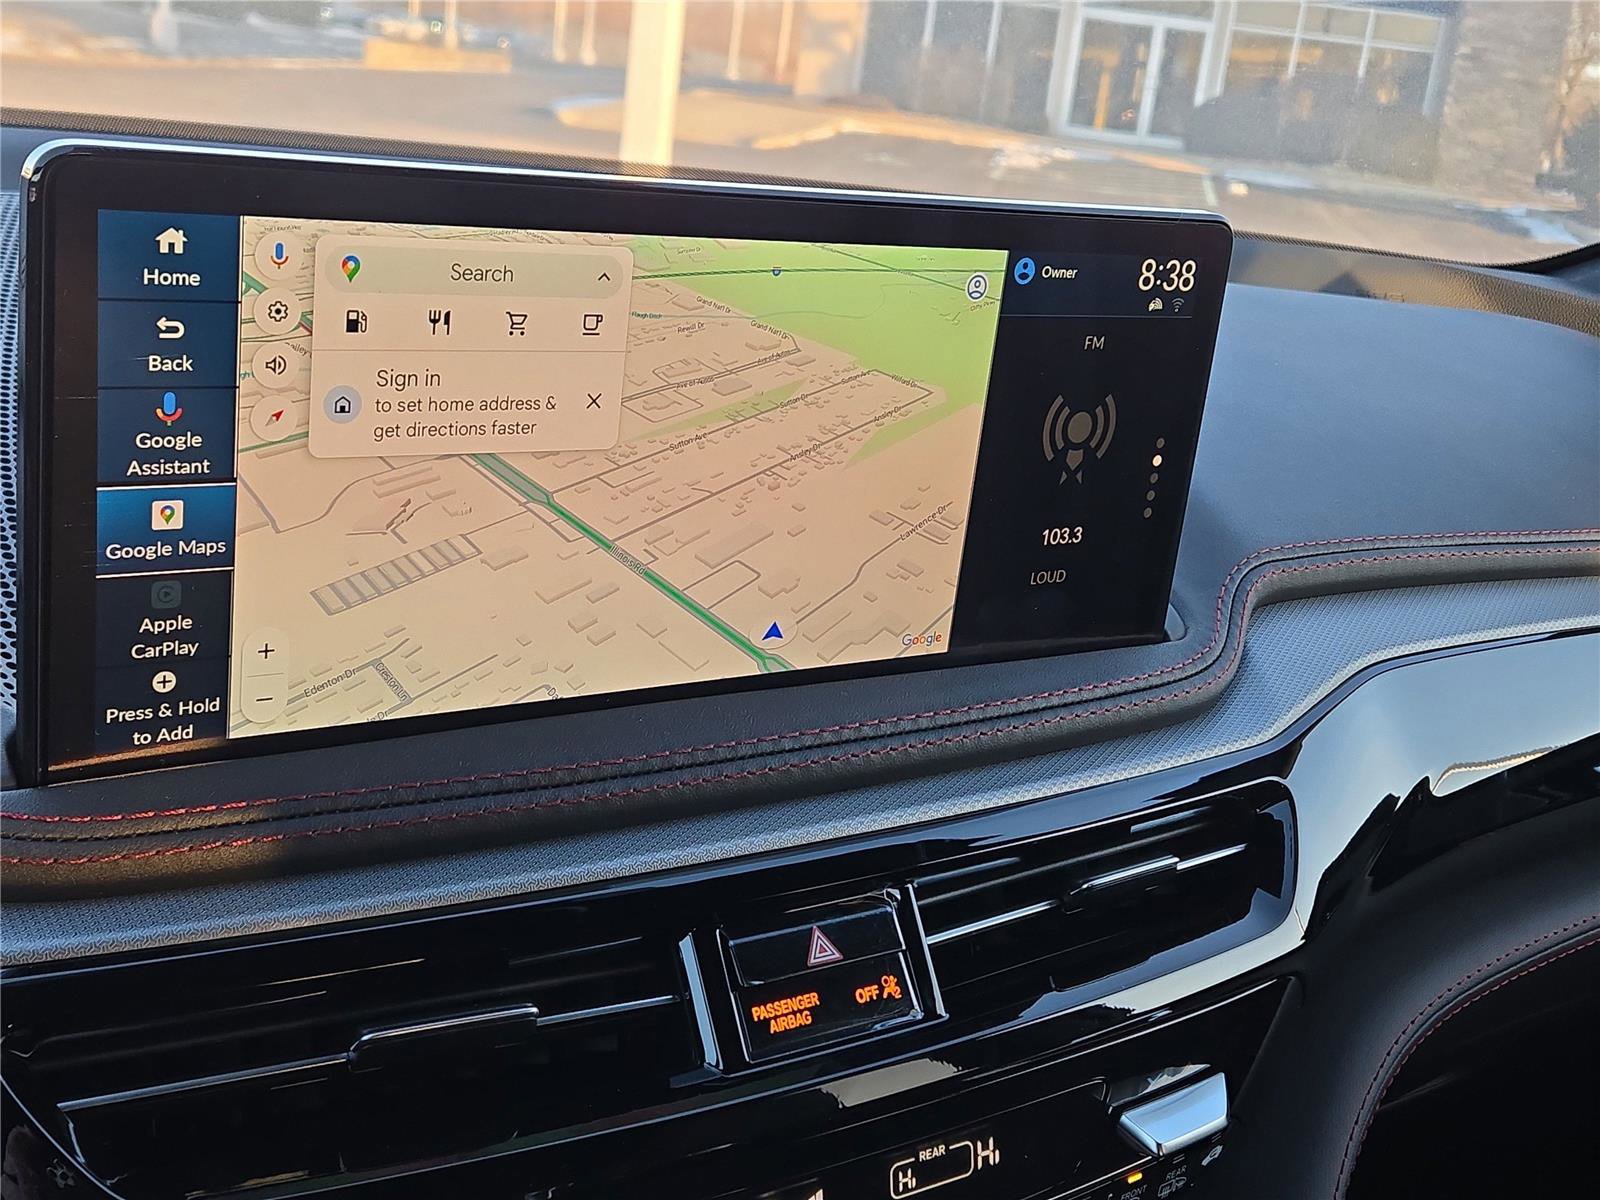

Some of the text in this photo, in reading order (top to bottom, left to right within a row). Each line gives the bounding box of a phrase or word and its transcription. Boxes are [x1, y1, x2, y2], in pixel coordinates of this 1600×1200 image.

[143, 268, 201, 286] Home
[450, 263, 514, 282] Search
[1041, 265, 1078, 280] Owner
[1138, 258, 1197, 292] 8:38
[750, 319, 768, 331] Grand
[1084, 336, 1105, 350] FM
[148, 355, 193, 372] Back
[376, 368, 441, 391] Sign in
[375, 395, 556, 413] to set home address &
[373, 420, 537, 442] get directions faster
[135, 432, 202, 450] Google
[669, 432, 707, 451] Sutton Ave
[126, 458, 211, 477] Assistant
[900, 503, 948, 542] Lawrence Dr
[1042, 526, 1083, 546] 103.3
[105, 539, 226, 561] Google Maps
[633, 562, 646, 575] Rd
[1030, 569, 1067, 585] LOUD
[139, 615, 193, 634] Apple
[902, 630, 942, 646] Google
[131, 640, 199, 659] CarPlay
[304, 667, 356, 698] Edenton Dr
[105, 697, 220, 724] Press & Hold
[132, 724, 193, 745] to Add
[855, 984, 879, 1004] OFF
[751, 992, 820, 1022] PASSENGER
[769, 1010, 812, 1034] AIRBAG
[919, 1144, 946, 1162] REAR
[1166, 1165, 1187, 1180] REAR
[1121, 1184, 1148, 1200] FRONT
